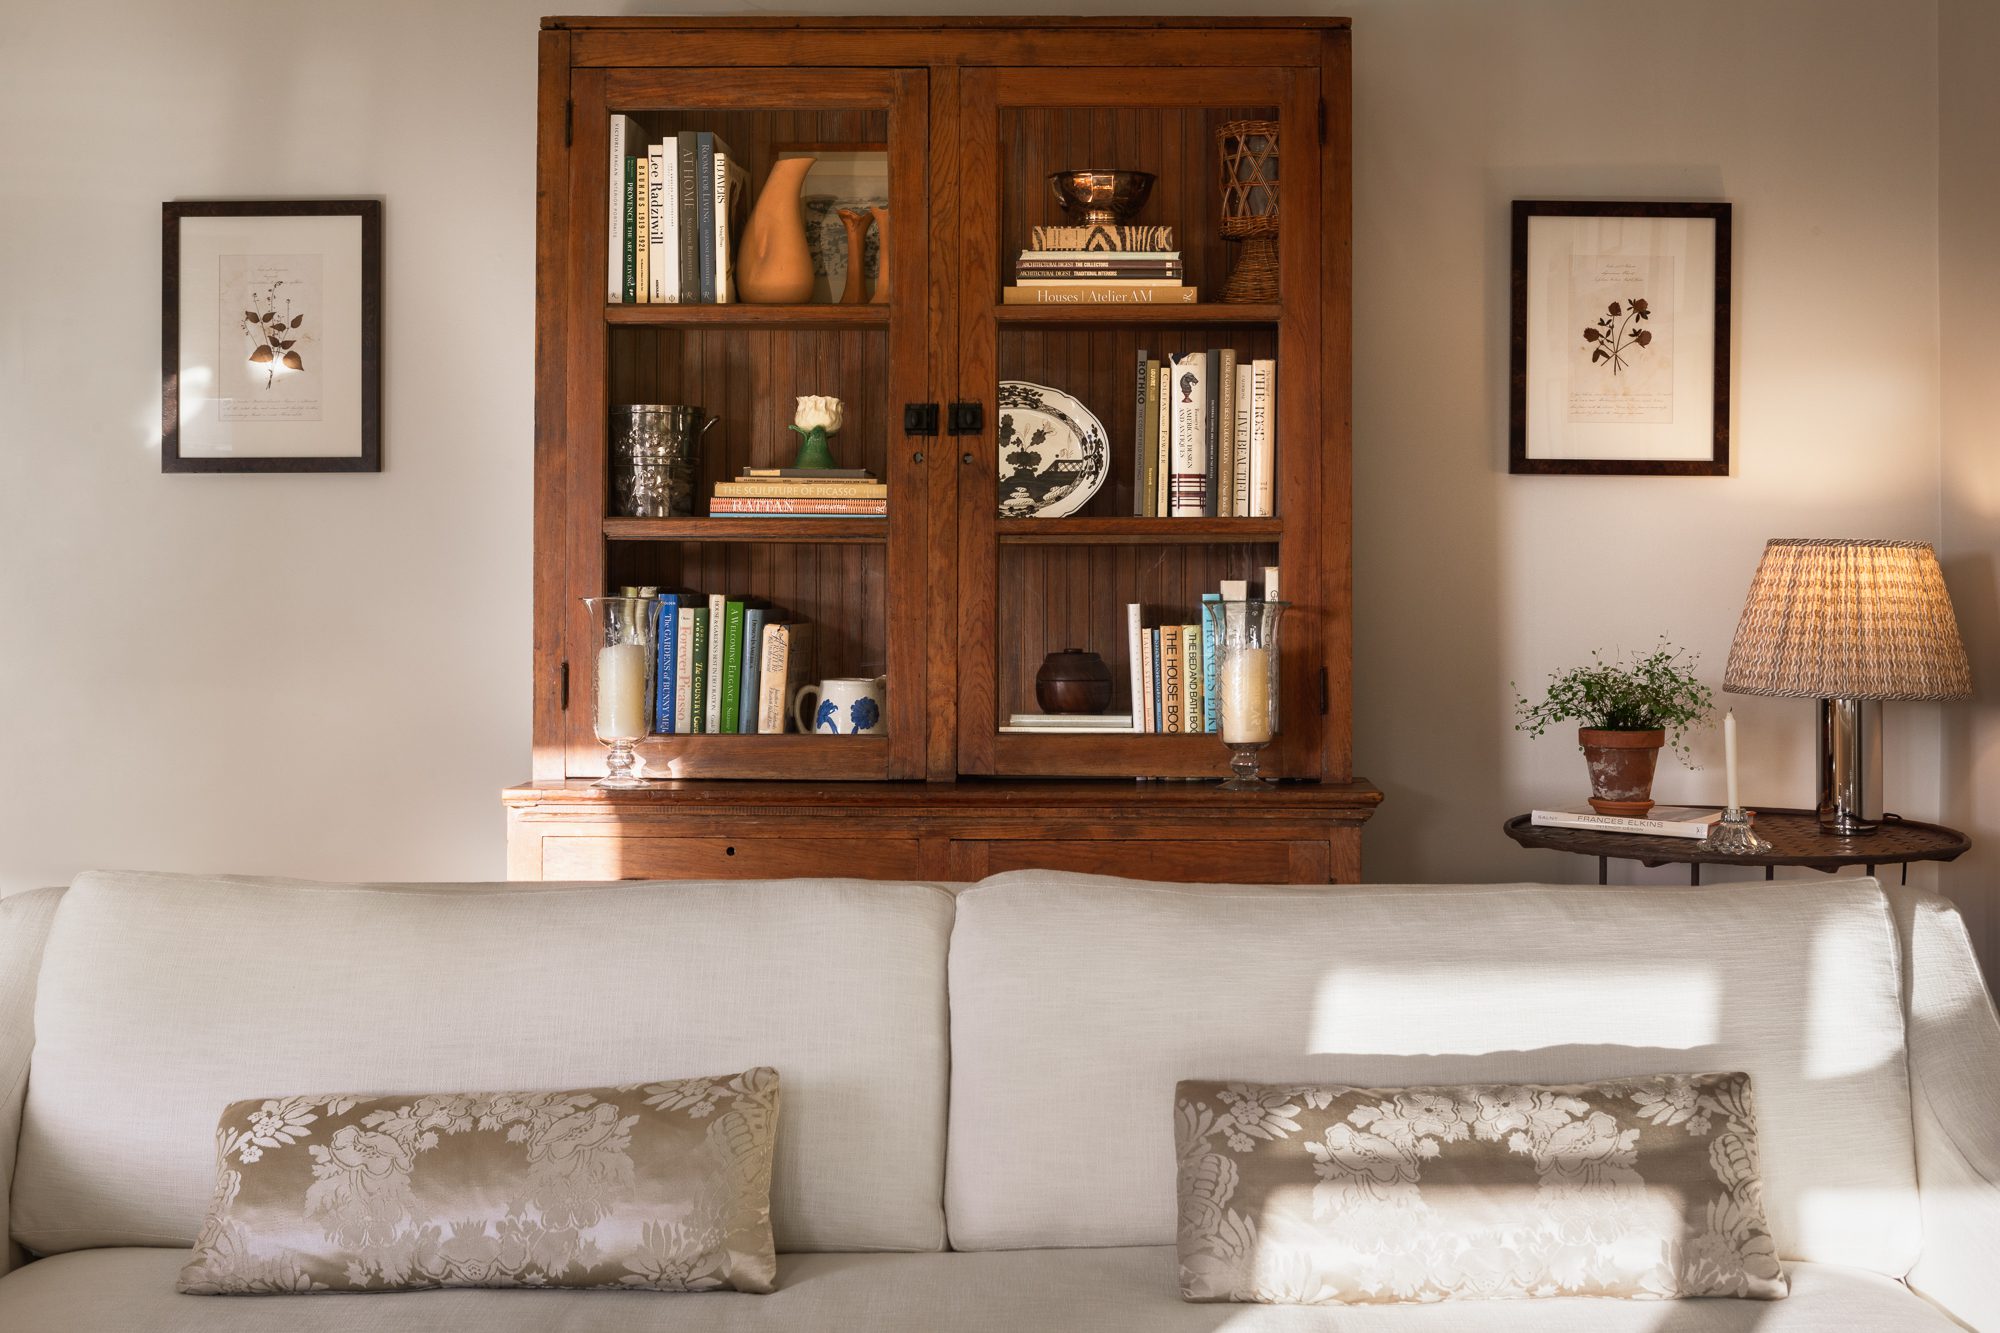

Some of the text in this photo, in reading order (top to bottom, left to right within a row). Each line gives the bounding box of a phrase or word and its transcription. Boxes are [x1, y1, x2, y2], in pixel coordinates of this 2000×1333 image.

[682, 148, 694, 210] AT HOME
[701, 144, 710, 174] ROOMS
[638, 165, 646, 207] BAUHAUS
[650, 154, 664, 245] Lee Radziwill
[716, 159, 726, 204] FLOWERS
[626, 182, 634, 223] PROVENCE
[702, 193, 711, 223] LIVING
[626, 264, 634, 286] LIVING
[627, 254, 633, 263] OF
[1037, 290, 1152, 302] Houses Atelier AM
[1137, 361, 1146, 405] ROTHKO
[1254, 370, 1266, 441] THE ROSE
[1235, 410, 1247, 505] LIVE BEAUTIFUL
[723, 486, 741, 495] THE
[743, 486, 798, 496] SCULPTURE
[801, 487, 814, 496] OF
[816, 487, 857, 496] PICASSO
[732, 500, 795, 512] RATTAN
[664, 613, 672, 628] The
[728, 616, 738, 663] WELCOMING
[663, 629, 672, 670] GARDENS
[679, 626, 691, 673] Forever
[695, 662, 703, 674] The
[662, 681, 671, 712] BUNNY
[677, 675, 691, 720] Picasso
[727, 665, 736, 702] ELEGANCE
[1166, 630, 1179, 733] THE HOUSE BOO
[1188, 633, 1198, 733] THE BED AND BATH BOO
[1207, 698, 1217, 733] ELKI
[1577, 815, 1664, 829] FRANCES ELKINS
